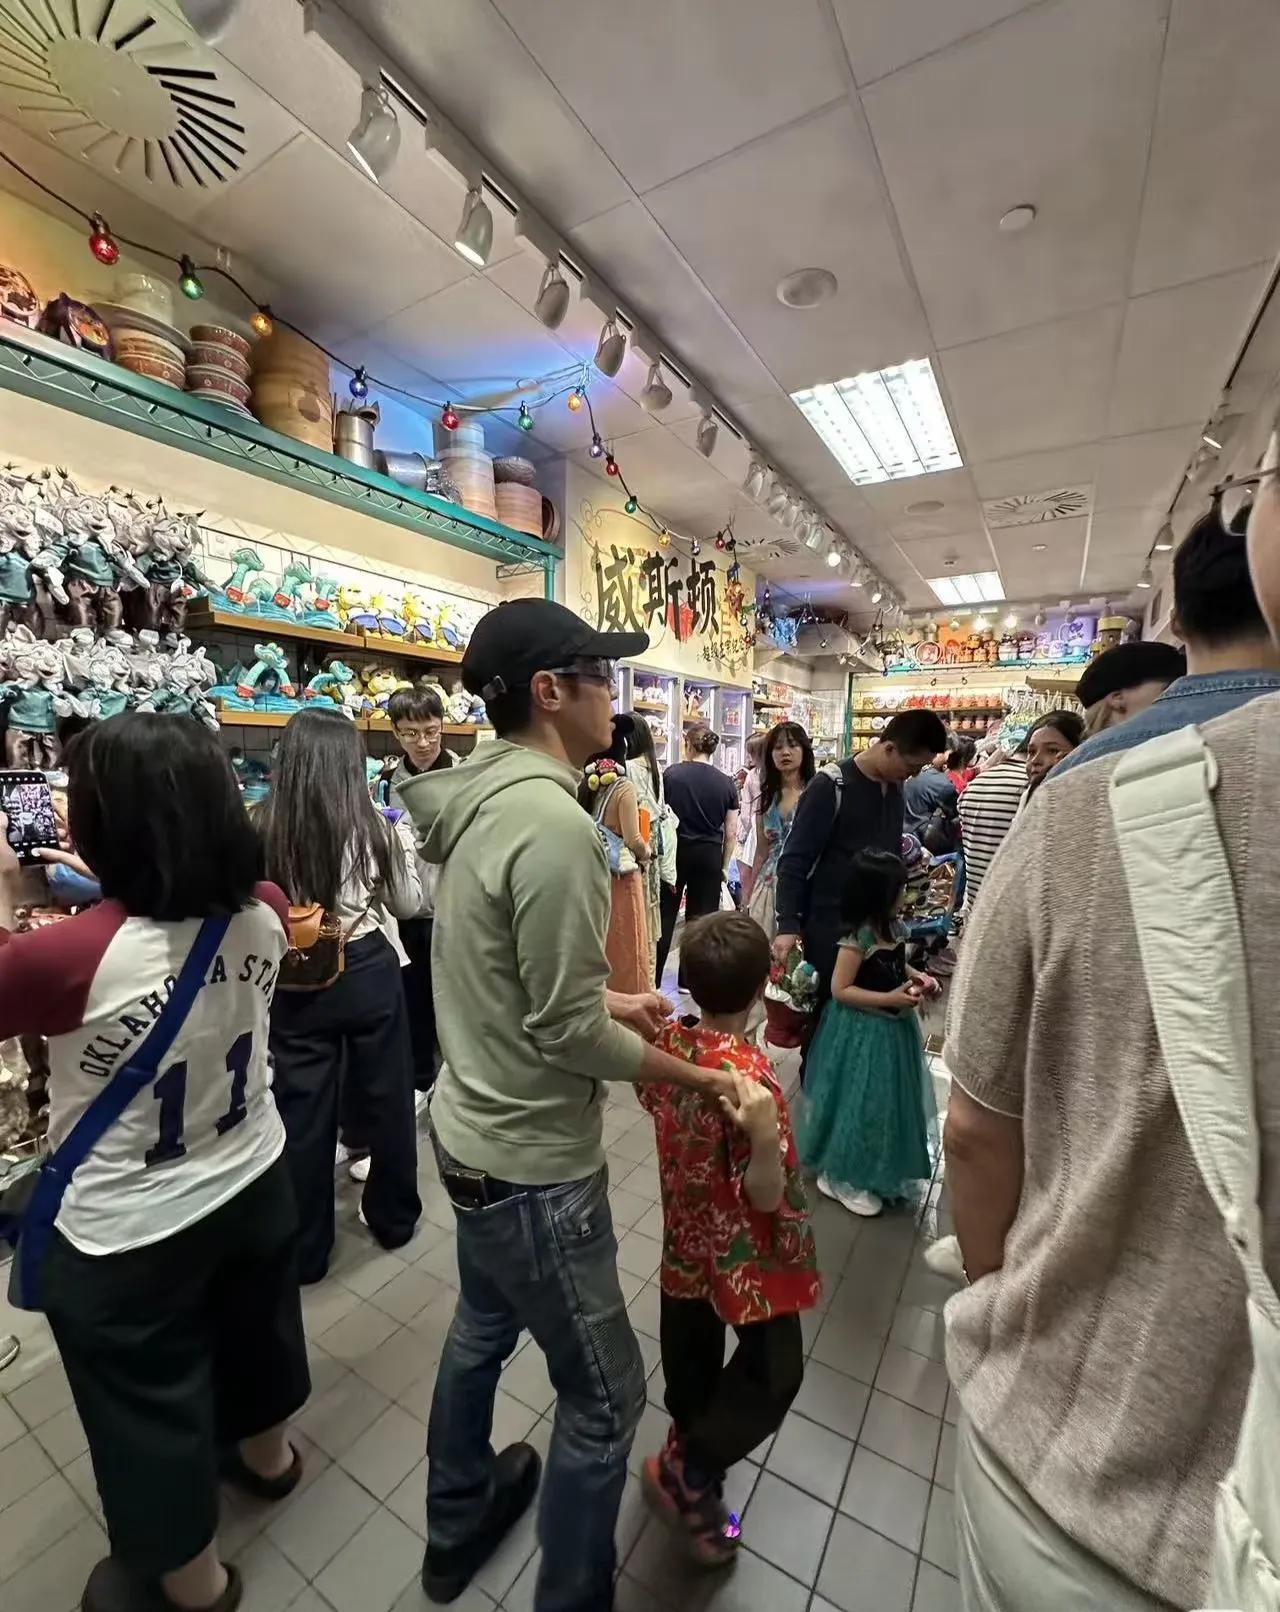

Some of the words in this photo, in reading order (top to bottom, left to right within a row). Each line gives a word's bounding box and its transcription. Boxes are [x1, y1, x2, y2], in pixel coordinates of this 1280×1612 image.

[596, 544, 719, 642] 威斯顿
[80, 955, 227, 1077] OKLAHOA
[145, 1031, 253, 1168] 11
